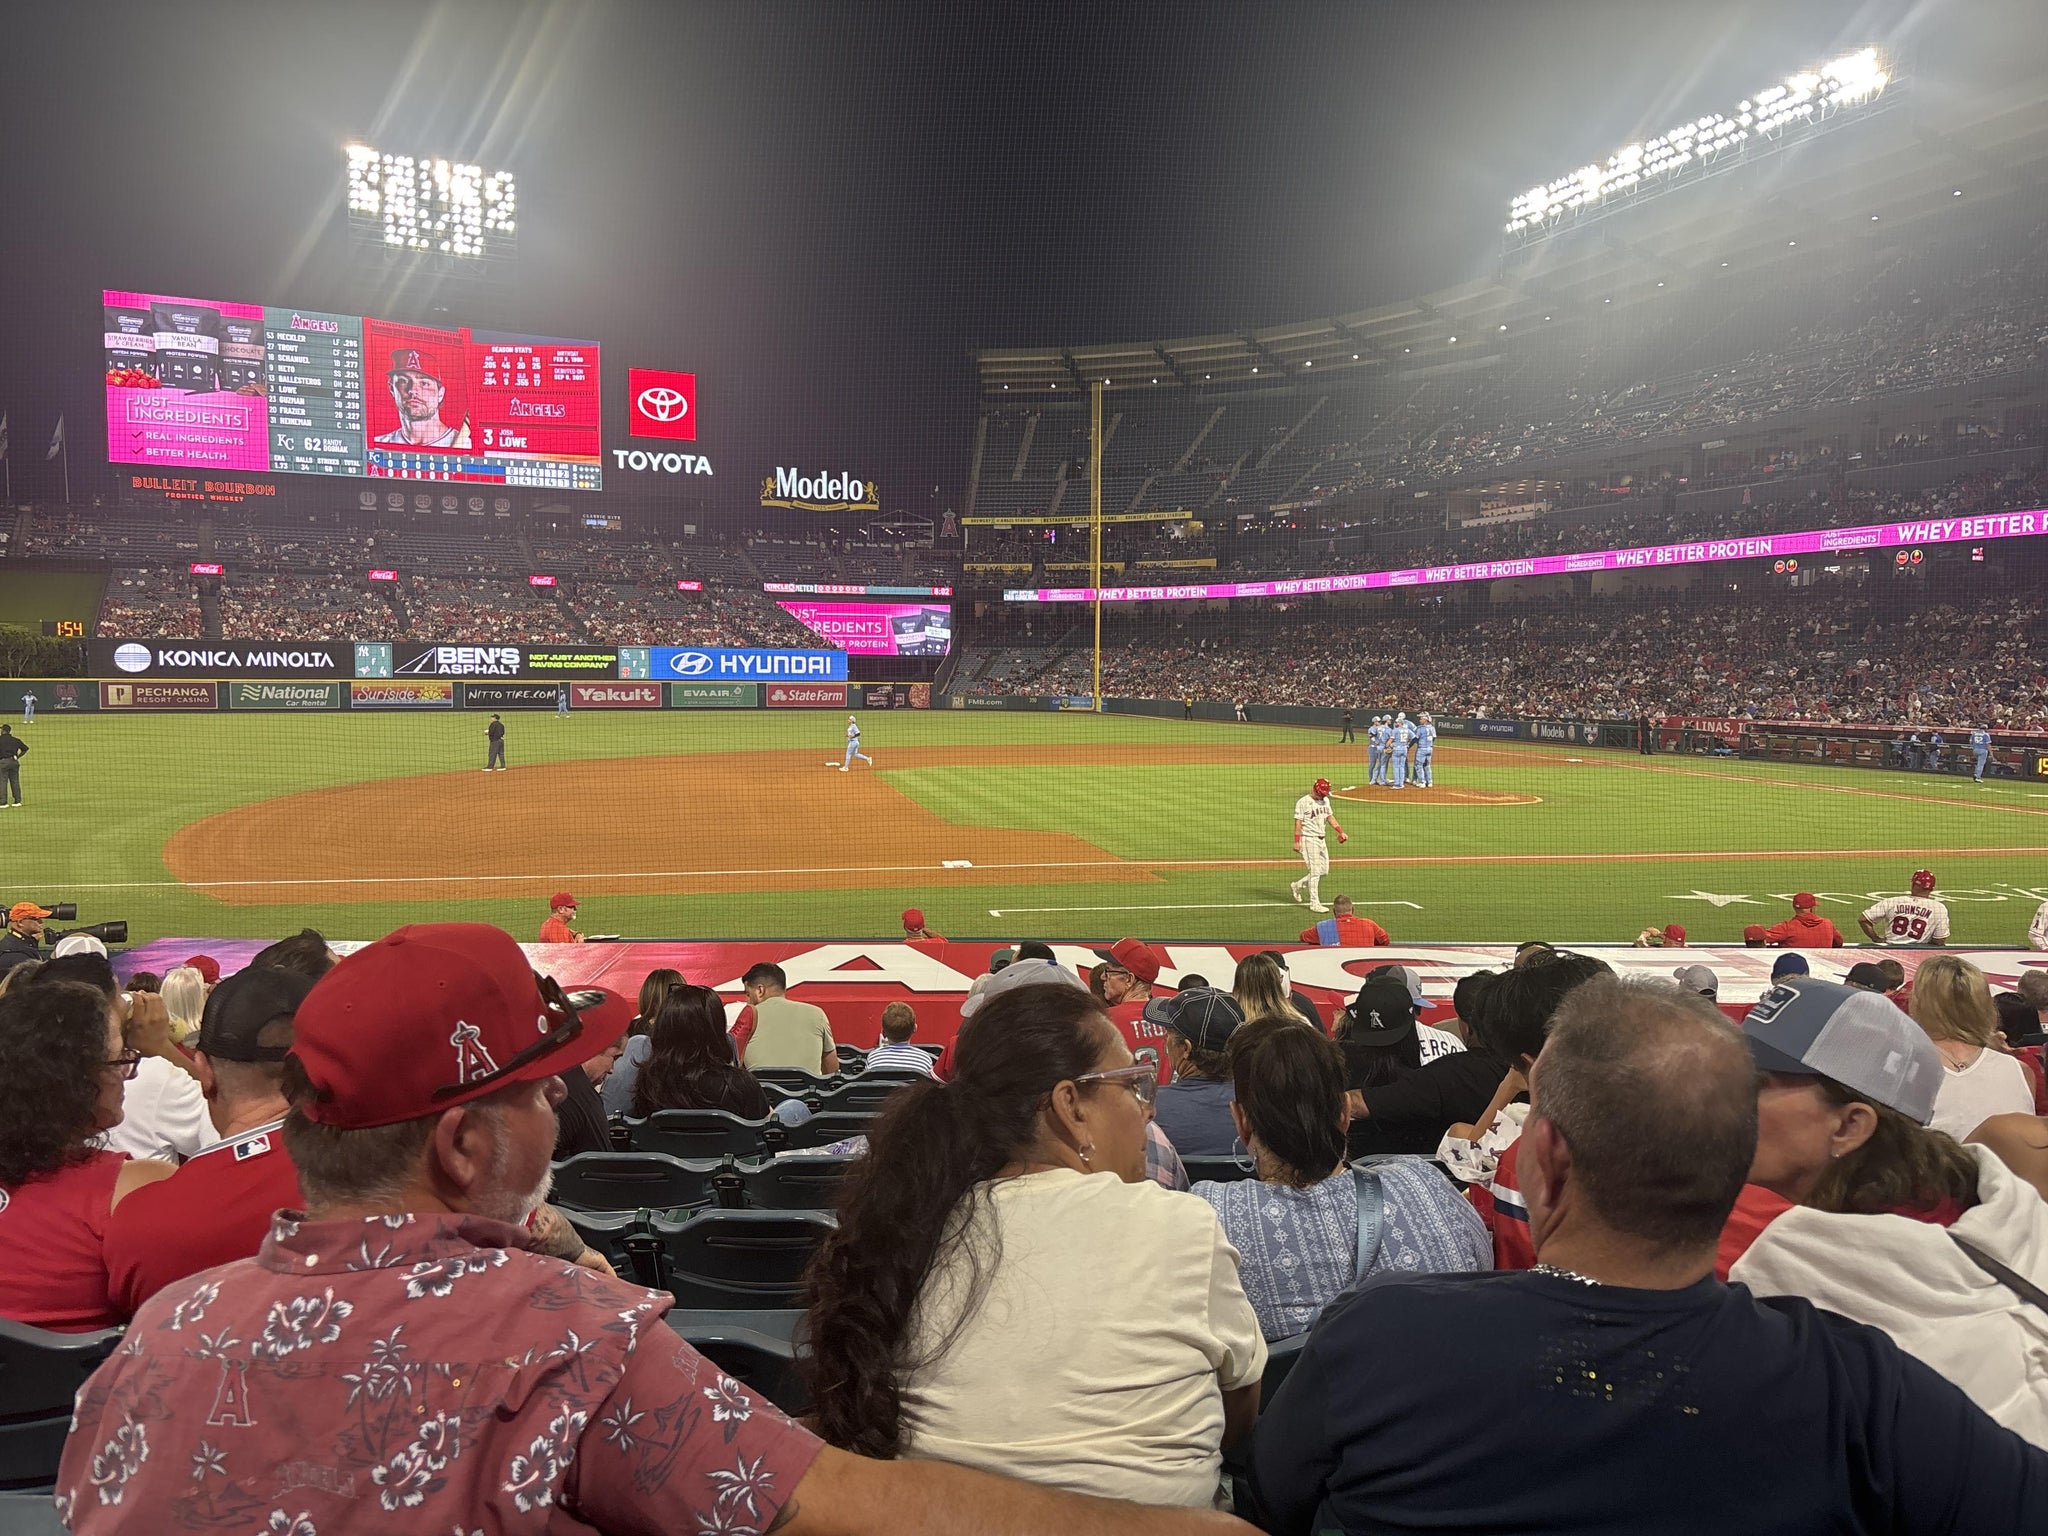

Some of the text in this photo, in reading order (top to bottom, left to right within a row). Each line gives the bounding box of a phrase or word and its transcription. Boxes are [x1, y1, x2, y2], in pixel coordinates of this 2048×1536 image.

[291, 313, 338, 333] ANGELS
[171, 335, 202, 344] VANILLA
[332, 338, 340, 346] LF
[277, 343, 299, 352] TROUT
[516, 362, 526, 370] 20
[344, 371, 359, 379] .224
[268, 374, 275, 382] 13
[344, 381, 359, 389] .212
[533, 379, 541, 387] 17
[278, 385, 297, 394] LOWE
[133, 395, 168, 407] JUST
[268, 395, 277, 403] 23
[509, 396, 566, 418] ANGELS
[134, 407, 242, 427] INGREDIENTS
[269, 416, 277, 424] 31
[345, 413, 360, 421] .227
[145, 431, 245, 446] REAL INGREDIENTS
[276, 433, 295, 451] KC
[482, 428, 494, 445] 3
[304, 436, 322, 452] 62
[499, 437, 528, 448] LOWE
[146, 447, 228, 460] BETTER HEALTH
[274, 462, 289, 470] 1.73
[612, 449, 714, 476] TOYOTA
[132, 476, 276, 496] BULLEIT BOURBON
[775, 466, 864, 501] Modelo
[165, 492, 245, 502] FRONTIER WHISKEY
[1898, 521, 1957, 543] WHEY
[1961, 516, 2035, 538] BETTER
[1823, 535, 1877, 547] INGREDIENTS
[1615, 539, 1773, 566] WHEY BETTER PROTEIN
[193, 564, 220, 575] Coca-Cola
[1425, 561, 1534, 581] WHEY BETTER PROTEIN
[1275, 576, 1367, 593] WHEY BETTER PROTEIN
[933, 587, 950, 595] 8:02
[1127, 588, 1164, 598] BETTER
[1166, 587, 1208, 597] PROTEIN
[56, 621, 83, 637] 1:54
[848, 640, 889, 648] PROTEIN
[379, 646, 386, 658] 1
[437, 646, 521, 665] BEN'S
[640, 650, 646, 661] 1
[158, 649, 335, 668] KONICA MINOLTA
[371, 658, 377, 666] F
[529, 654, 617, 662] NOT JUST ANOTHER
[437, 664, 521, 675] ASPHALT
[529, 661, 609, 669] PAVING COMPANY
[720, 654, 831, 675] HYUNDAI
[379, 666, 388, 677] 4
[639, 668, 646, 679] 7
[136, 687, 209, 697] PECHANGA
[262, 685, 330, 700] National
[357, 685, 415, 702] Surfside
[468, 689, 557, 700] NITTO TIRE.COM
[577, 687, 656, 702] Yakult
[683, 689, 730, 697] EVA AIR
[788, 689, 843, 702] StateFarm
[967, 698, 1003, 706] FMB.com
[1437, 721, 1464, 730] FMB.com
[1489, 725, 1514, 733] HYUNDAI
[1540, 724, 1565, 739] Modelo
[1894, 904, 1933, 919] JOHNSON
[1891, 916, 1928, 941] 89
